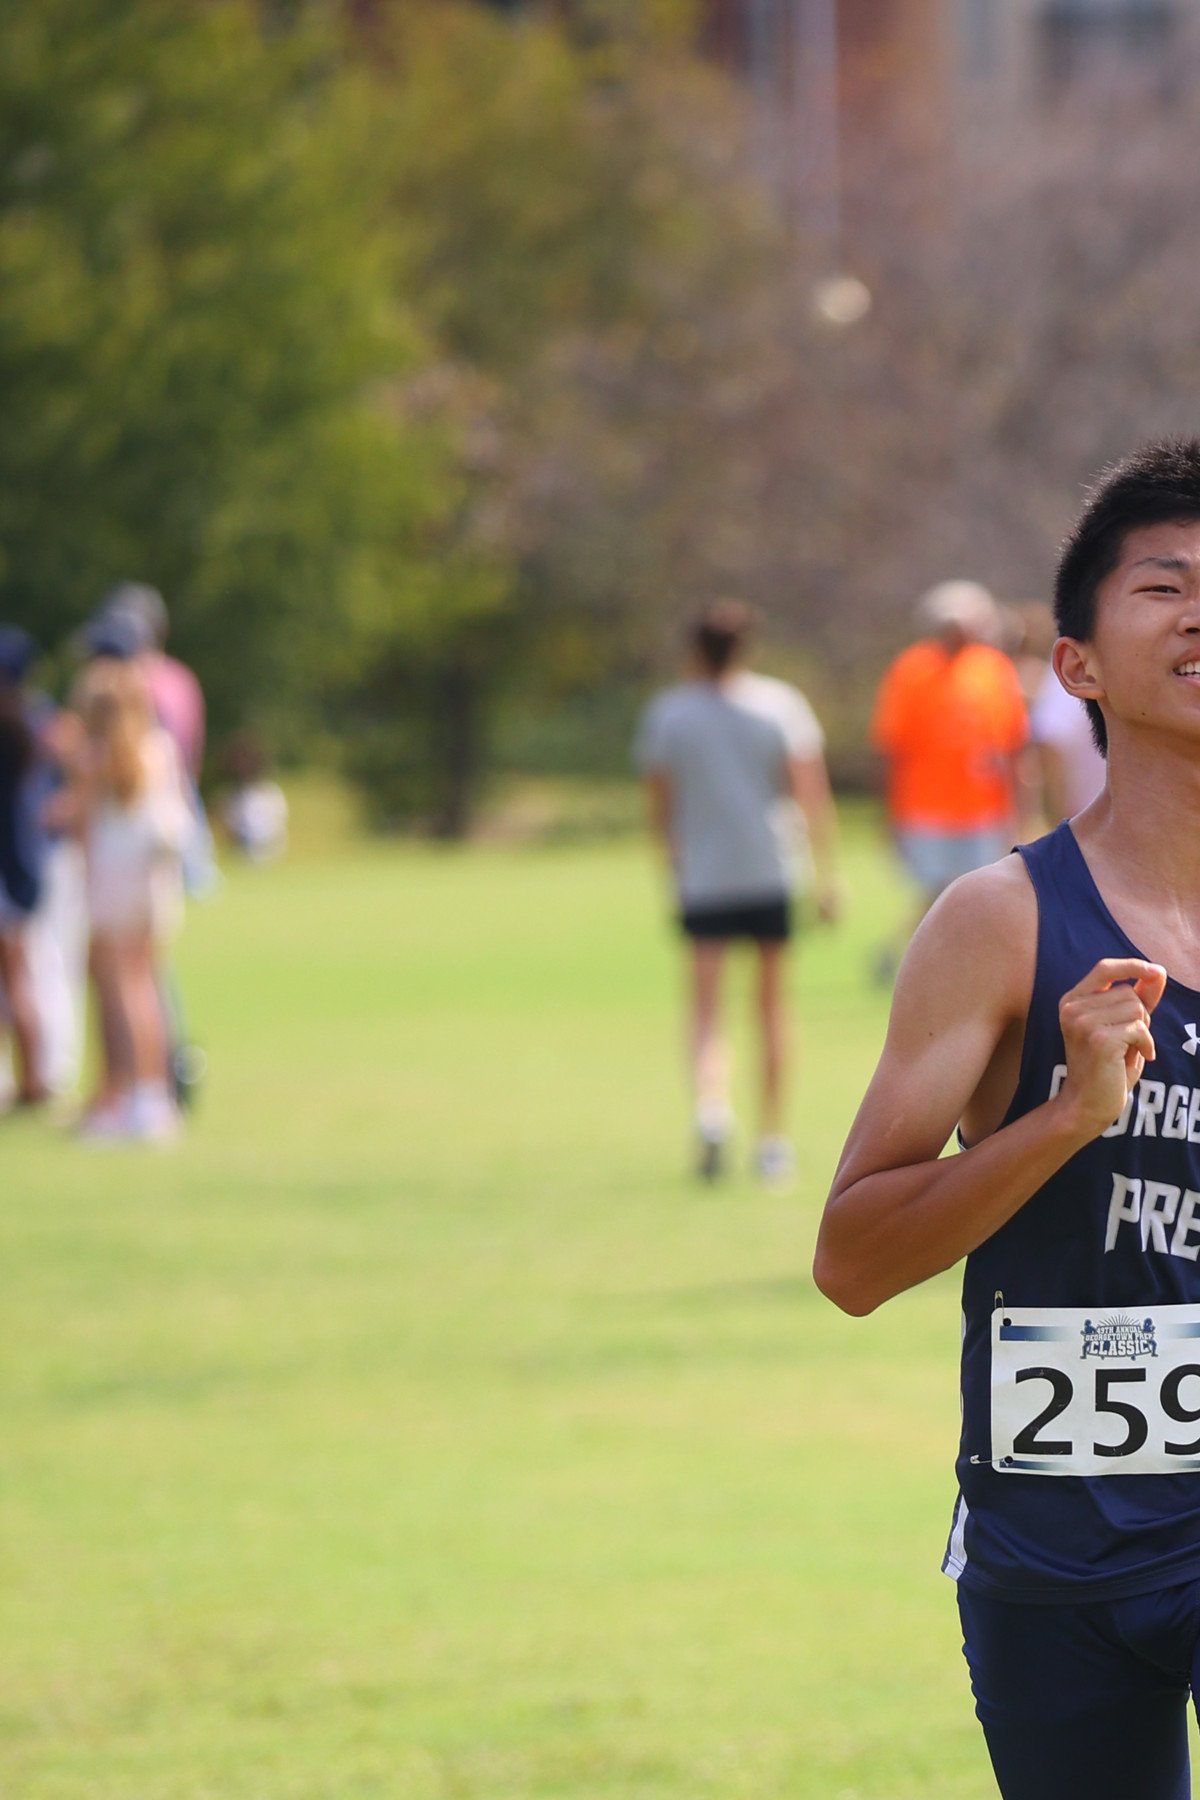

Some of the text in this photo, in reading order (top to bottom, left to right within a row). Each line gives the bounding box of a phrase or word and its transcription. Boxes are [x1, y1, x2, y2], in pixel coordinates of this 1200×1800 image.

[1096, 1326, 1114, 1334] 49TH
[1085, 1332, 1153, 1341] GEORGETOWN PREP
[1089, 1340, 1150, 1356] CLASSIC
